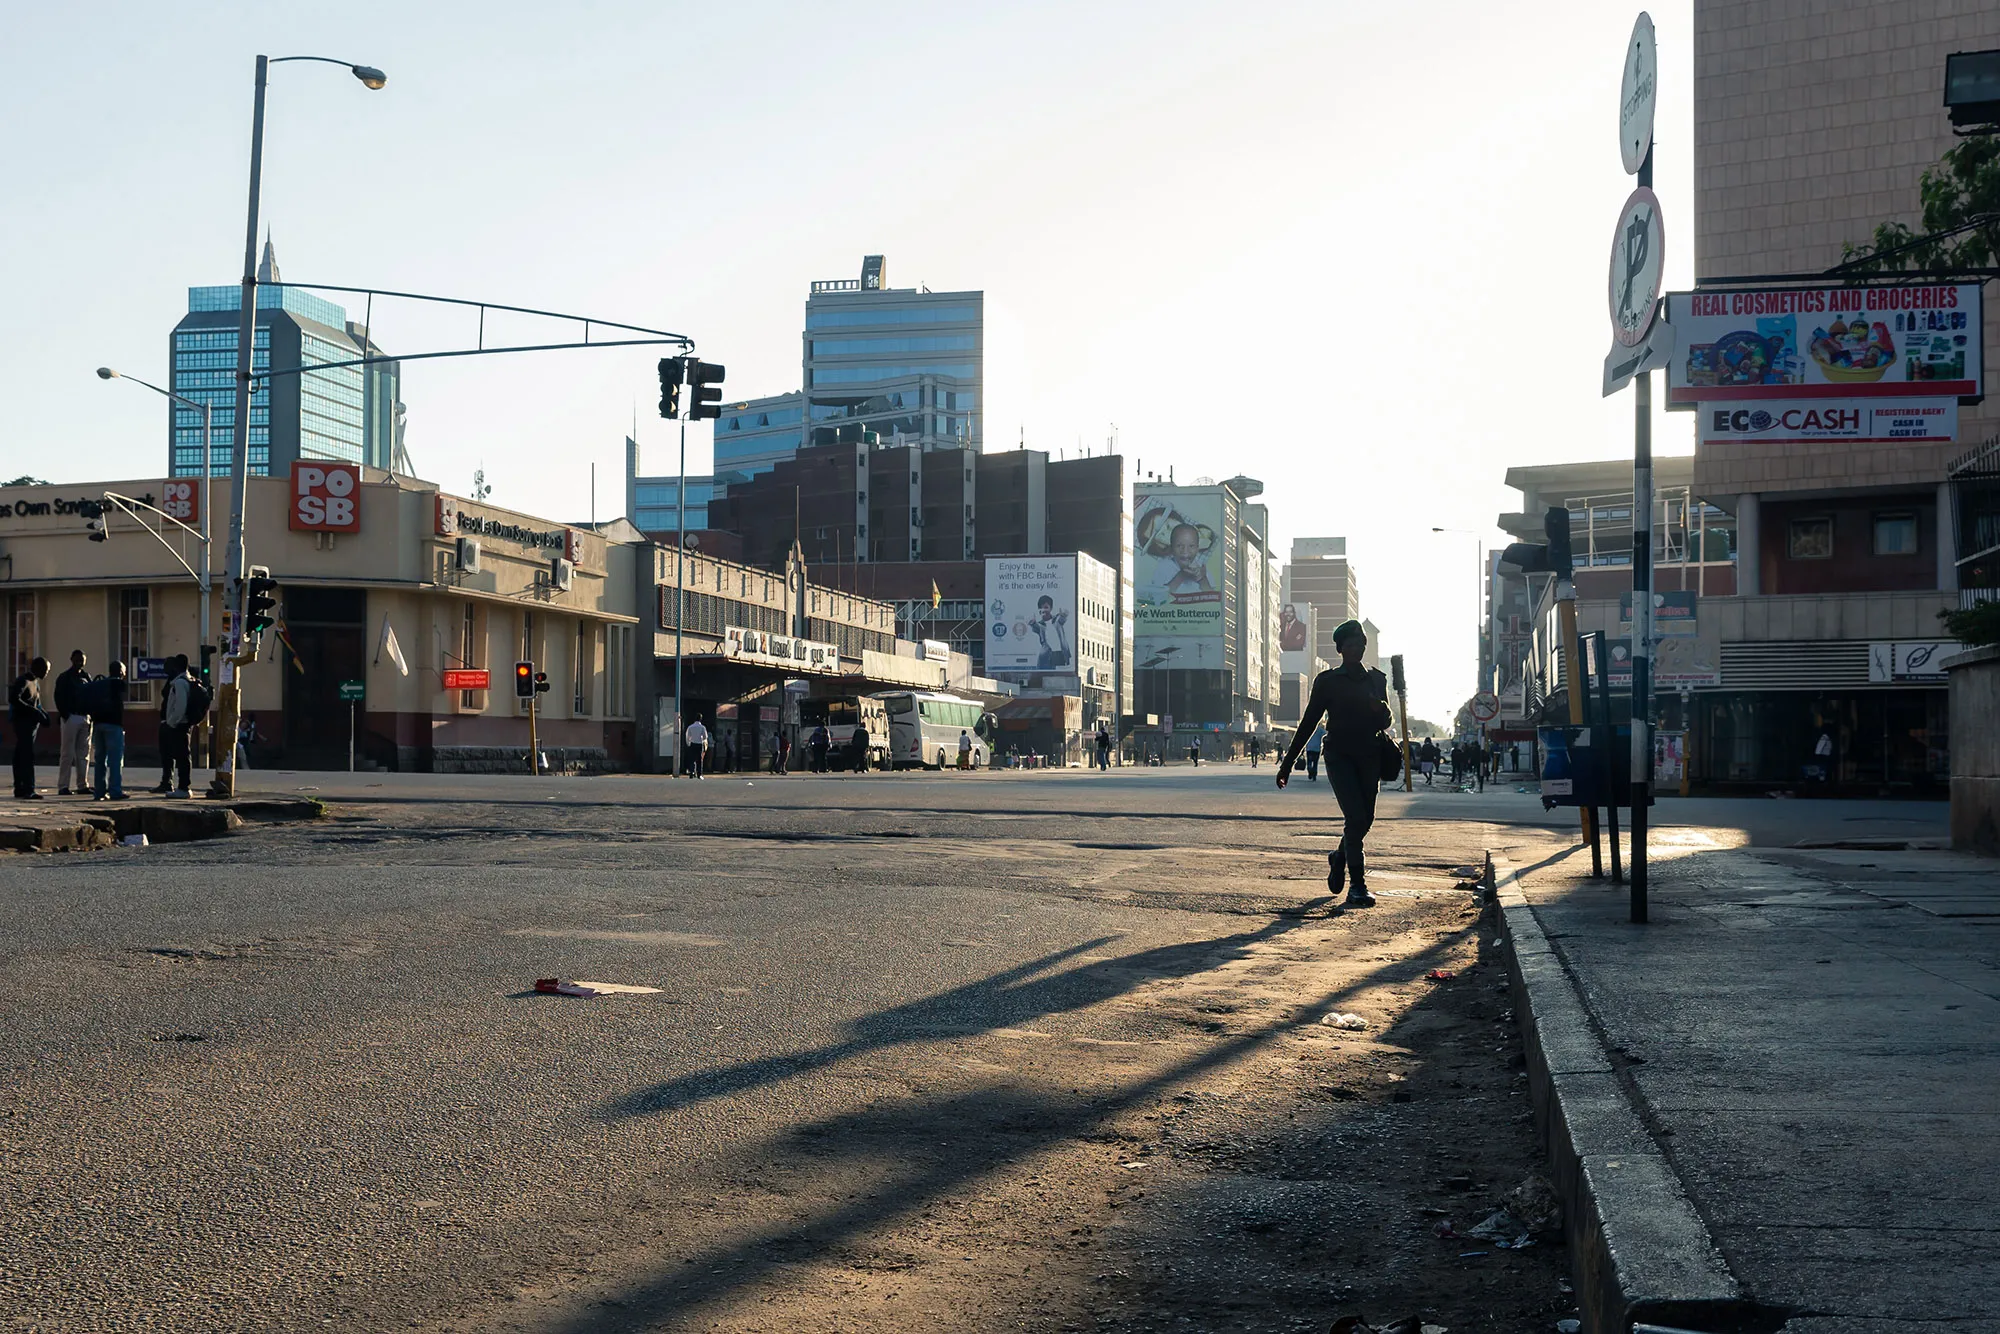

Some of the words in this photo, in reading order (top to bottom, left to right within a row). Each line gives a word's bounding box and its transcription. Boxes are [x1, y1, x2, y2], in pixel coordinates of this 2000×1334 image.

[1623, 71, 1652, 126] STOPPING
[1691, 294, 1729, 316] REAL
[1732, 290, 1825, 315] COSMETICS
[1828, 290, 1862, 312] AND
[1866, 286, 1958, 310] GROCERIES
[1875, 408, 1920, 416] REGISTERED
[1921, 407, 1946, 415] AGENT
[15, 500, 51, 517] Own
[495, 520, 515, 539] Own
[999, 562, 1021, 571] Enjoy
[999, 572, 1014, 580] with
[1026, 582, 1044, 590] easy
[1133, 609, 1148, 618] We
[1150, 609, 1176, 618] Want
[1177, 609, 1221, 620] Buttercup
